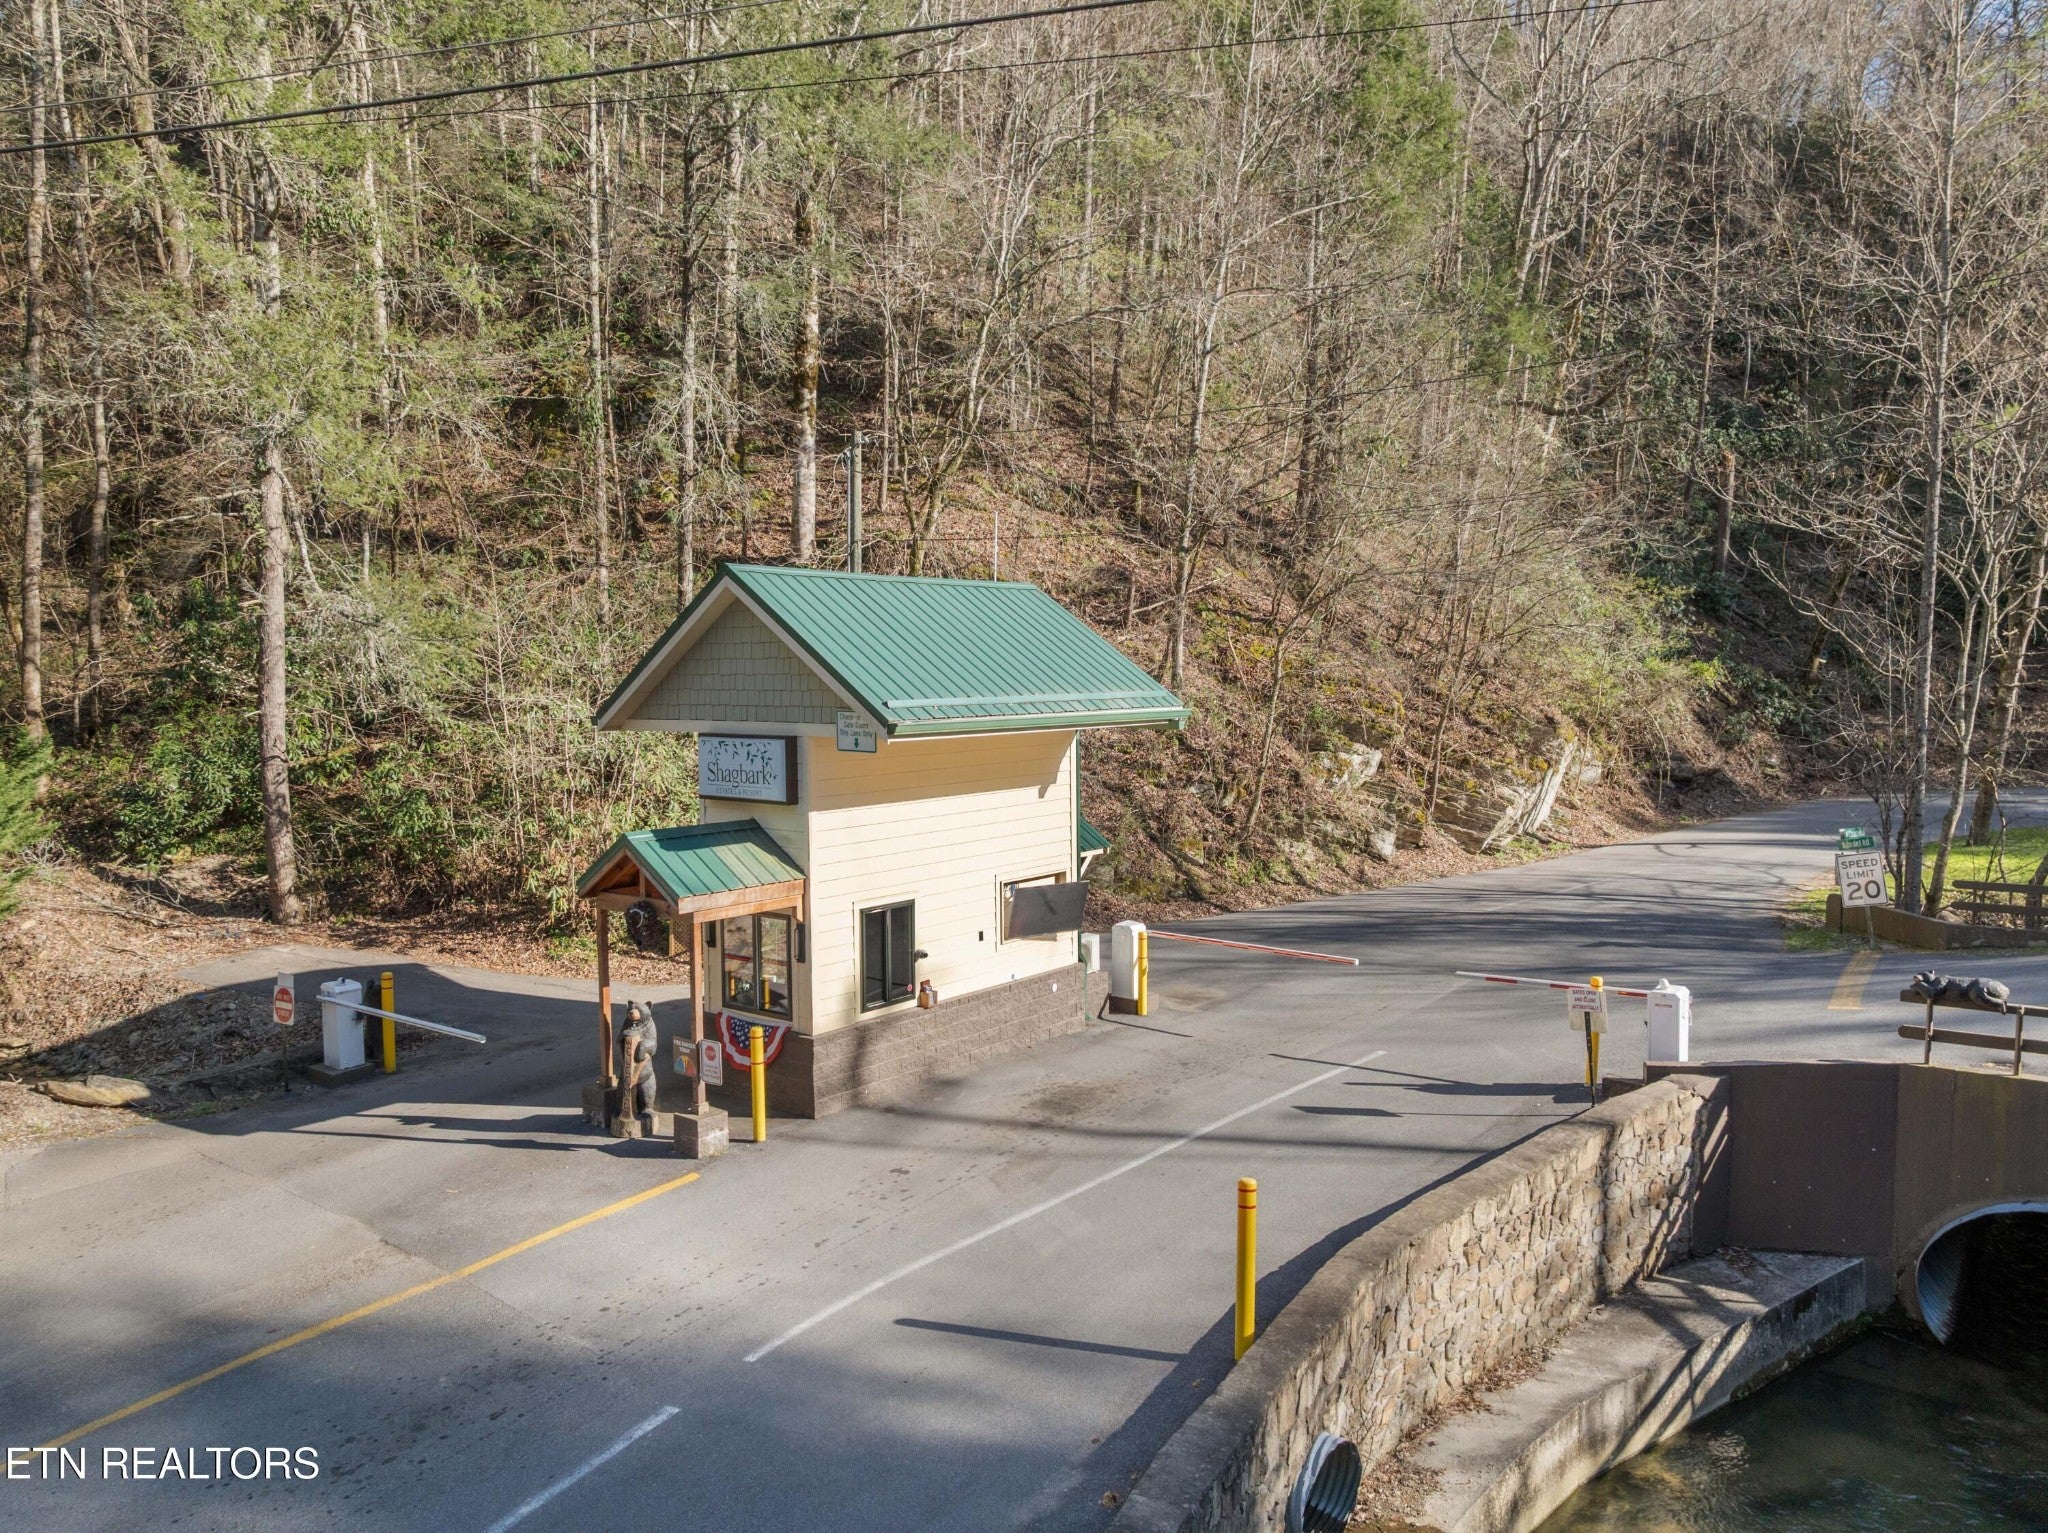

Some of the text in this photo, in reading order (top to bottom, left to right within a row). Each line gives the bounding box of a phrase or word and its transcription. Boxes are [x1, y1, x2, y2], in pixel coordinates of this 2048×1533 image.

[707, 760, 771, 788] Shagbark
[716, 787, 737, 795] ESTATES
[1841, 858, 1878, 869] SPEED
[1846, 869, 1875, 880] LIMIT
[1846, 880, 1881, 900] 20
